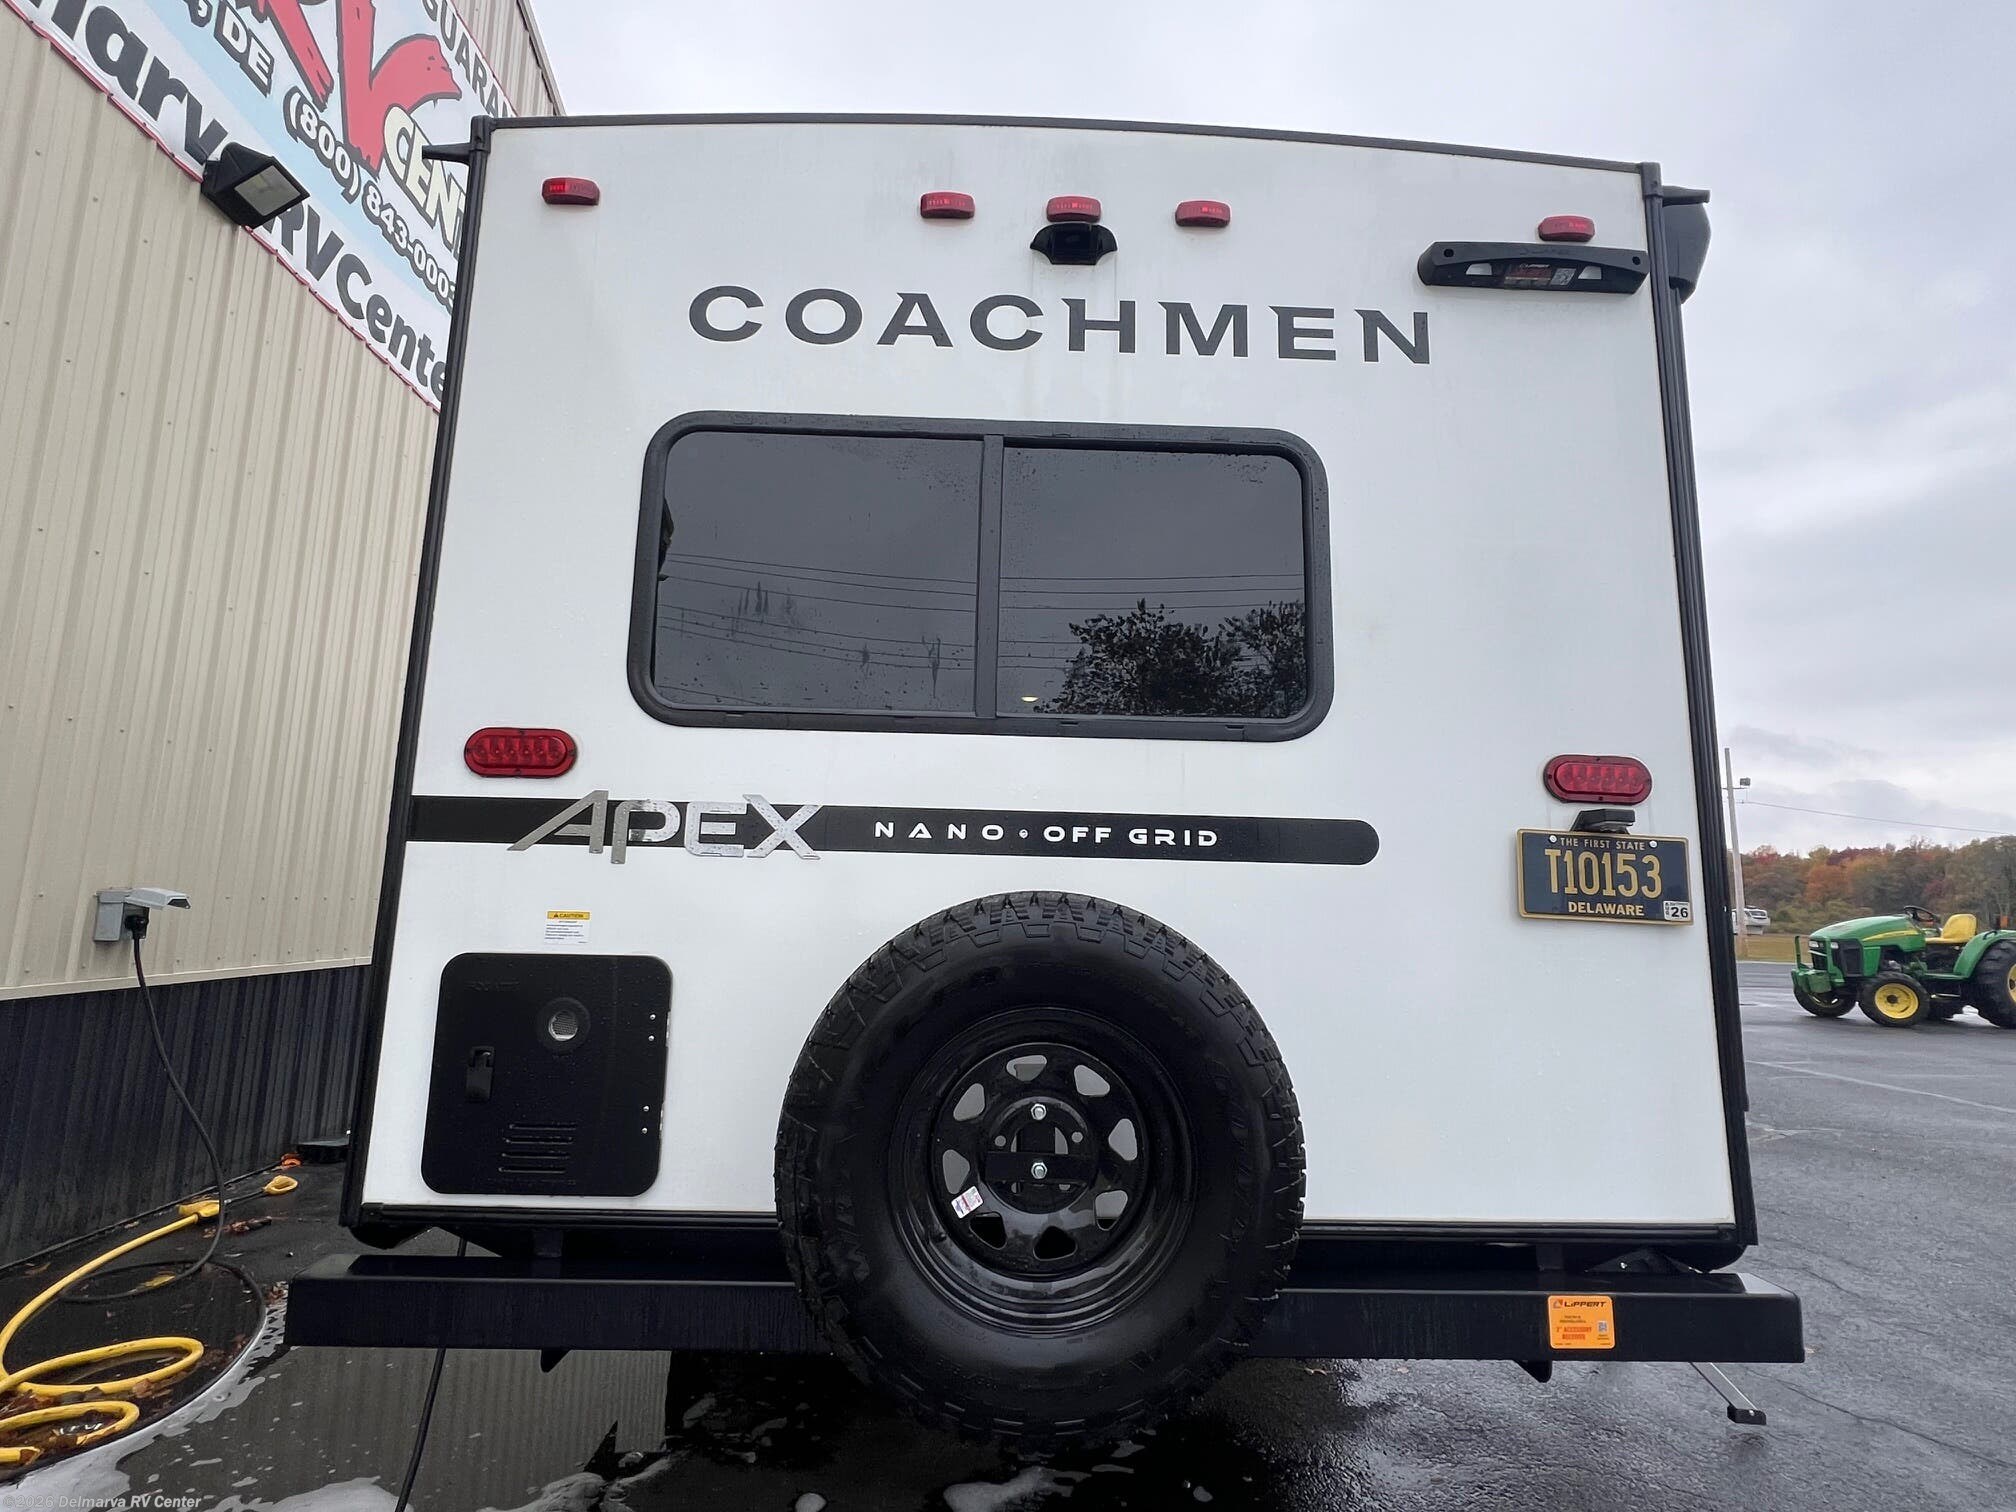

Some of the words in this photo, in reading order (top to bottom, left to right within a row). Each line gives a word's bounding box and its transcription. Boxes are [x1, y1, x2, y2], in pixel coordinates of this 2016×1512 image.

[422, 0, 511, 117] UARA
[216, 2, 273, 95] DE
[287, 88, 360, 201] (800)
[384, 104, 466, 260] CEN
[689, 285, 1430, 364] COACHMEN
[506, 790, 823, 864] APEX
[875, 821, 1004, 840] NANO
[1043, 825, 1111, 844] OFF
[1128, 828, 1218, 846] GRID
[1560, 837, 1579, 847] THE
[1584, 839, 1610, 849] FIRST
[1616, 841, 1645, 851] STATE
[1545, 848, 1662, 898] T10153
[1568, 901, 1644, 916] DELAWARE
[1671, 906, 1688, 918] 26
